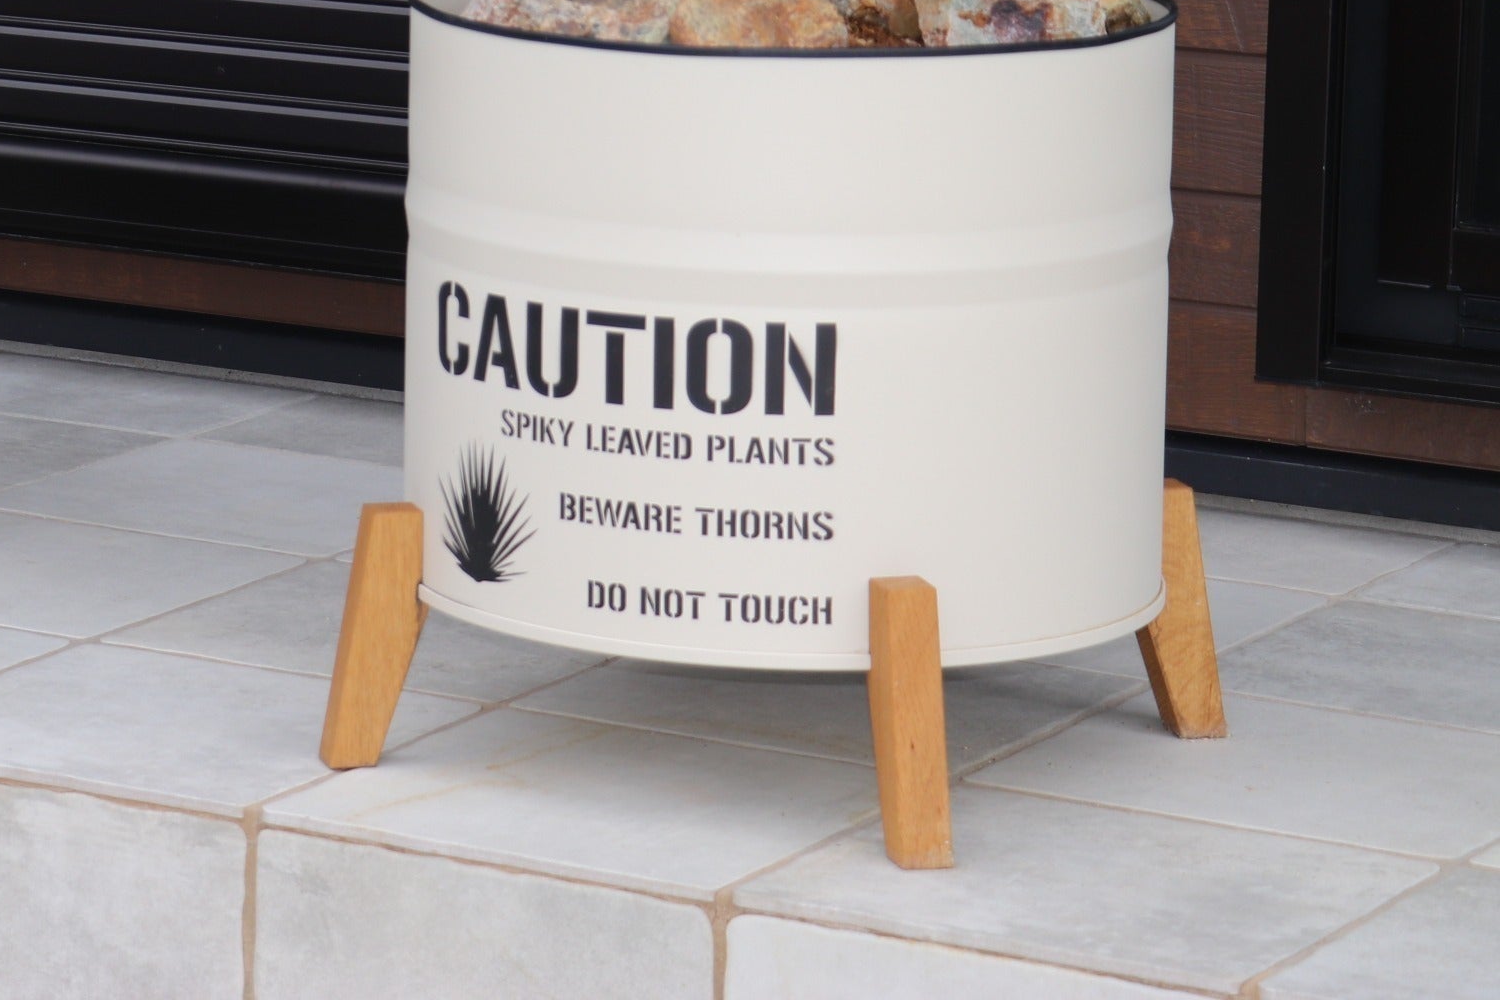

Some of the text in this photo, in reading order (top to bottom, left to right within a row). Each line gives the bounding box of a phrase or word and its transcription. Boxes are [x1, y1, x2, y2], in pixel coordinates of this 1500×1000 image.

[437, 280, 837, 416] CAUTION
[500, 408, 836, 467] SPIKY LEAVED PLANTS
[558, 491, 835, 542] BEWARE THORNS
[587, 579, 834, 626] DO NOT TOUCH
